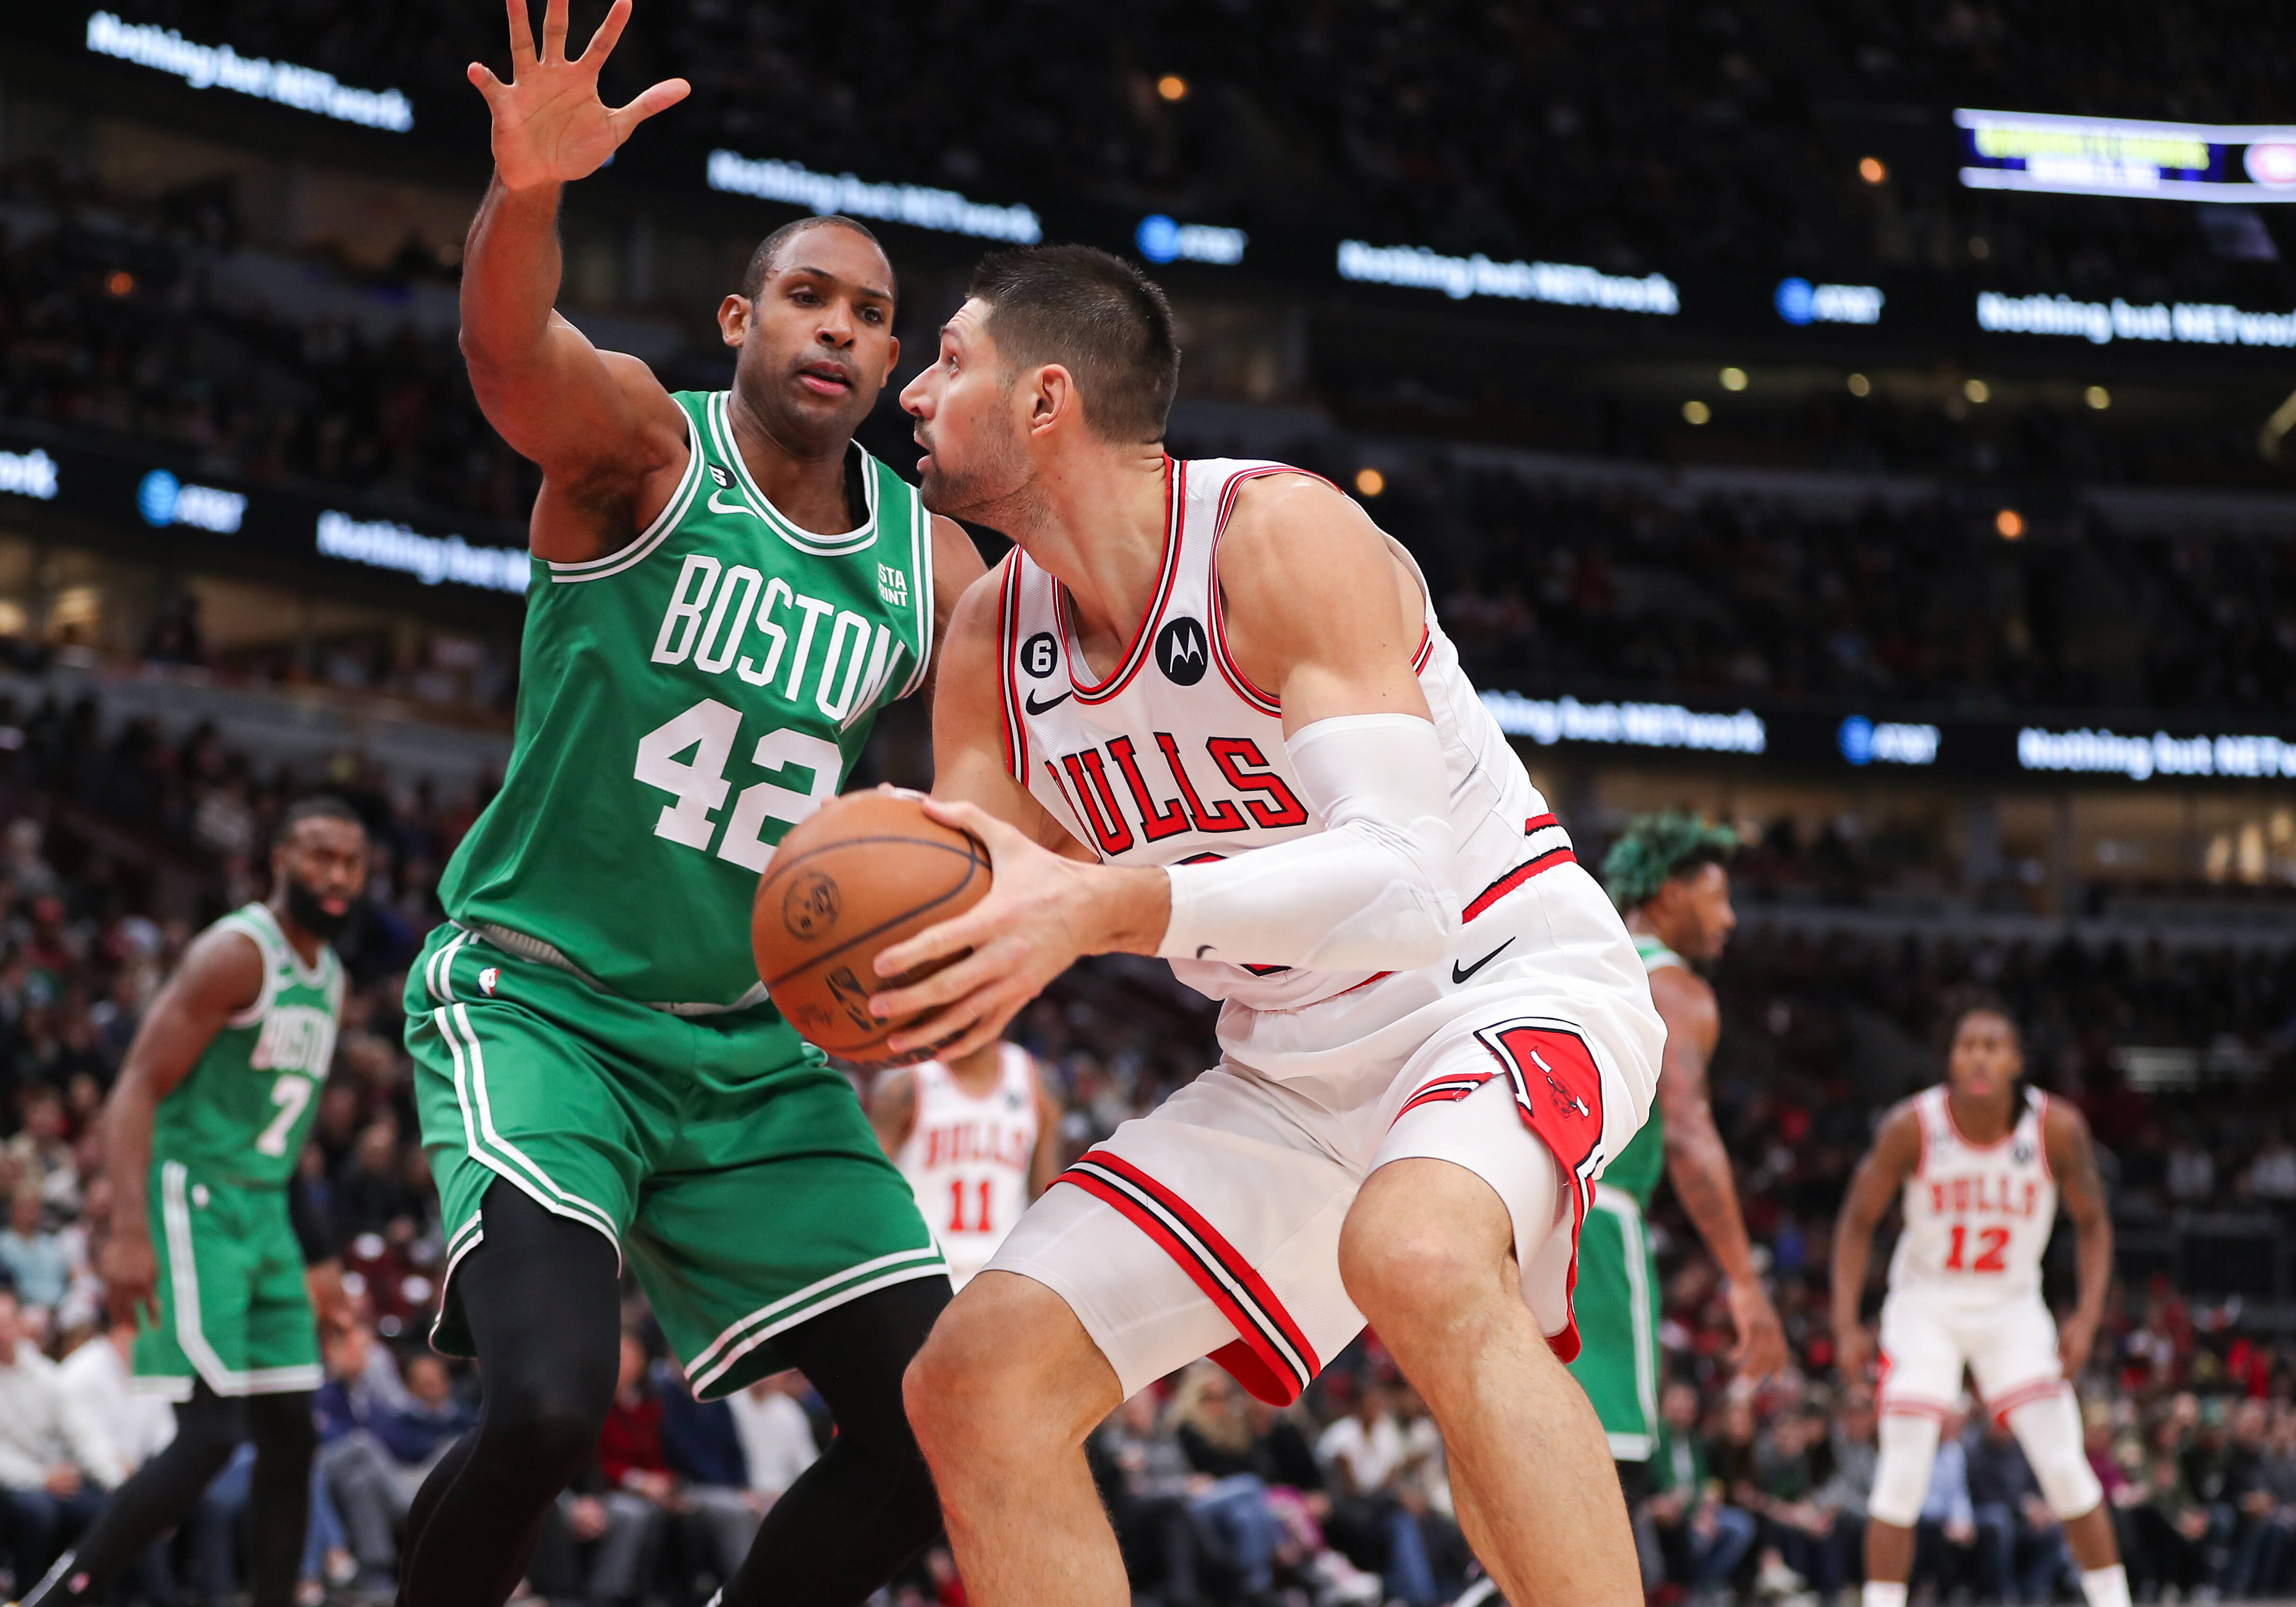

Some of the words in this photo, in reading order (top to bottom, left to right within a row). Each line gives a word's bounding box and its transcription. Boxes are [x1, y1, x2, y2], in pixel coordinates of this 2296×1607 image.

[650, 554, 906, 733] BOSTON
[1033, 640, 1051, 672] 6
[633, 698, 843, 875] 42
[256, 1075, 313, 1157] 7
[949, 1180, 992, 1232] 11
[1945, 1225, 2011, 1273] 12
